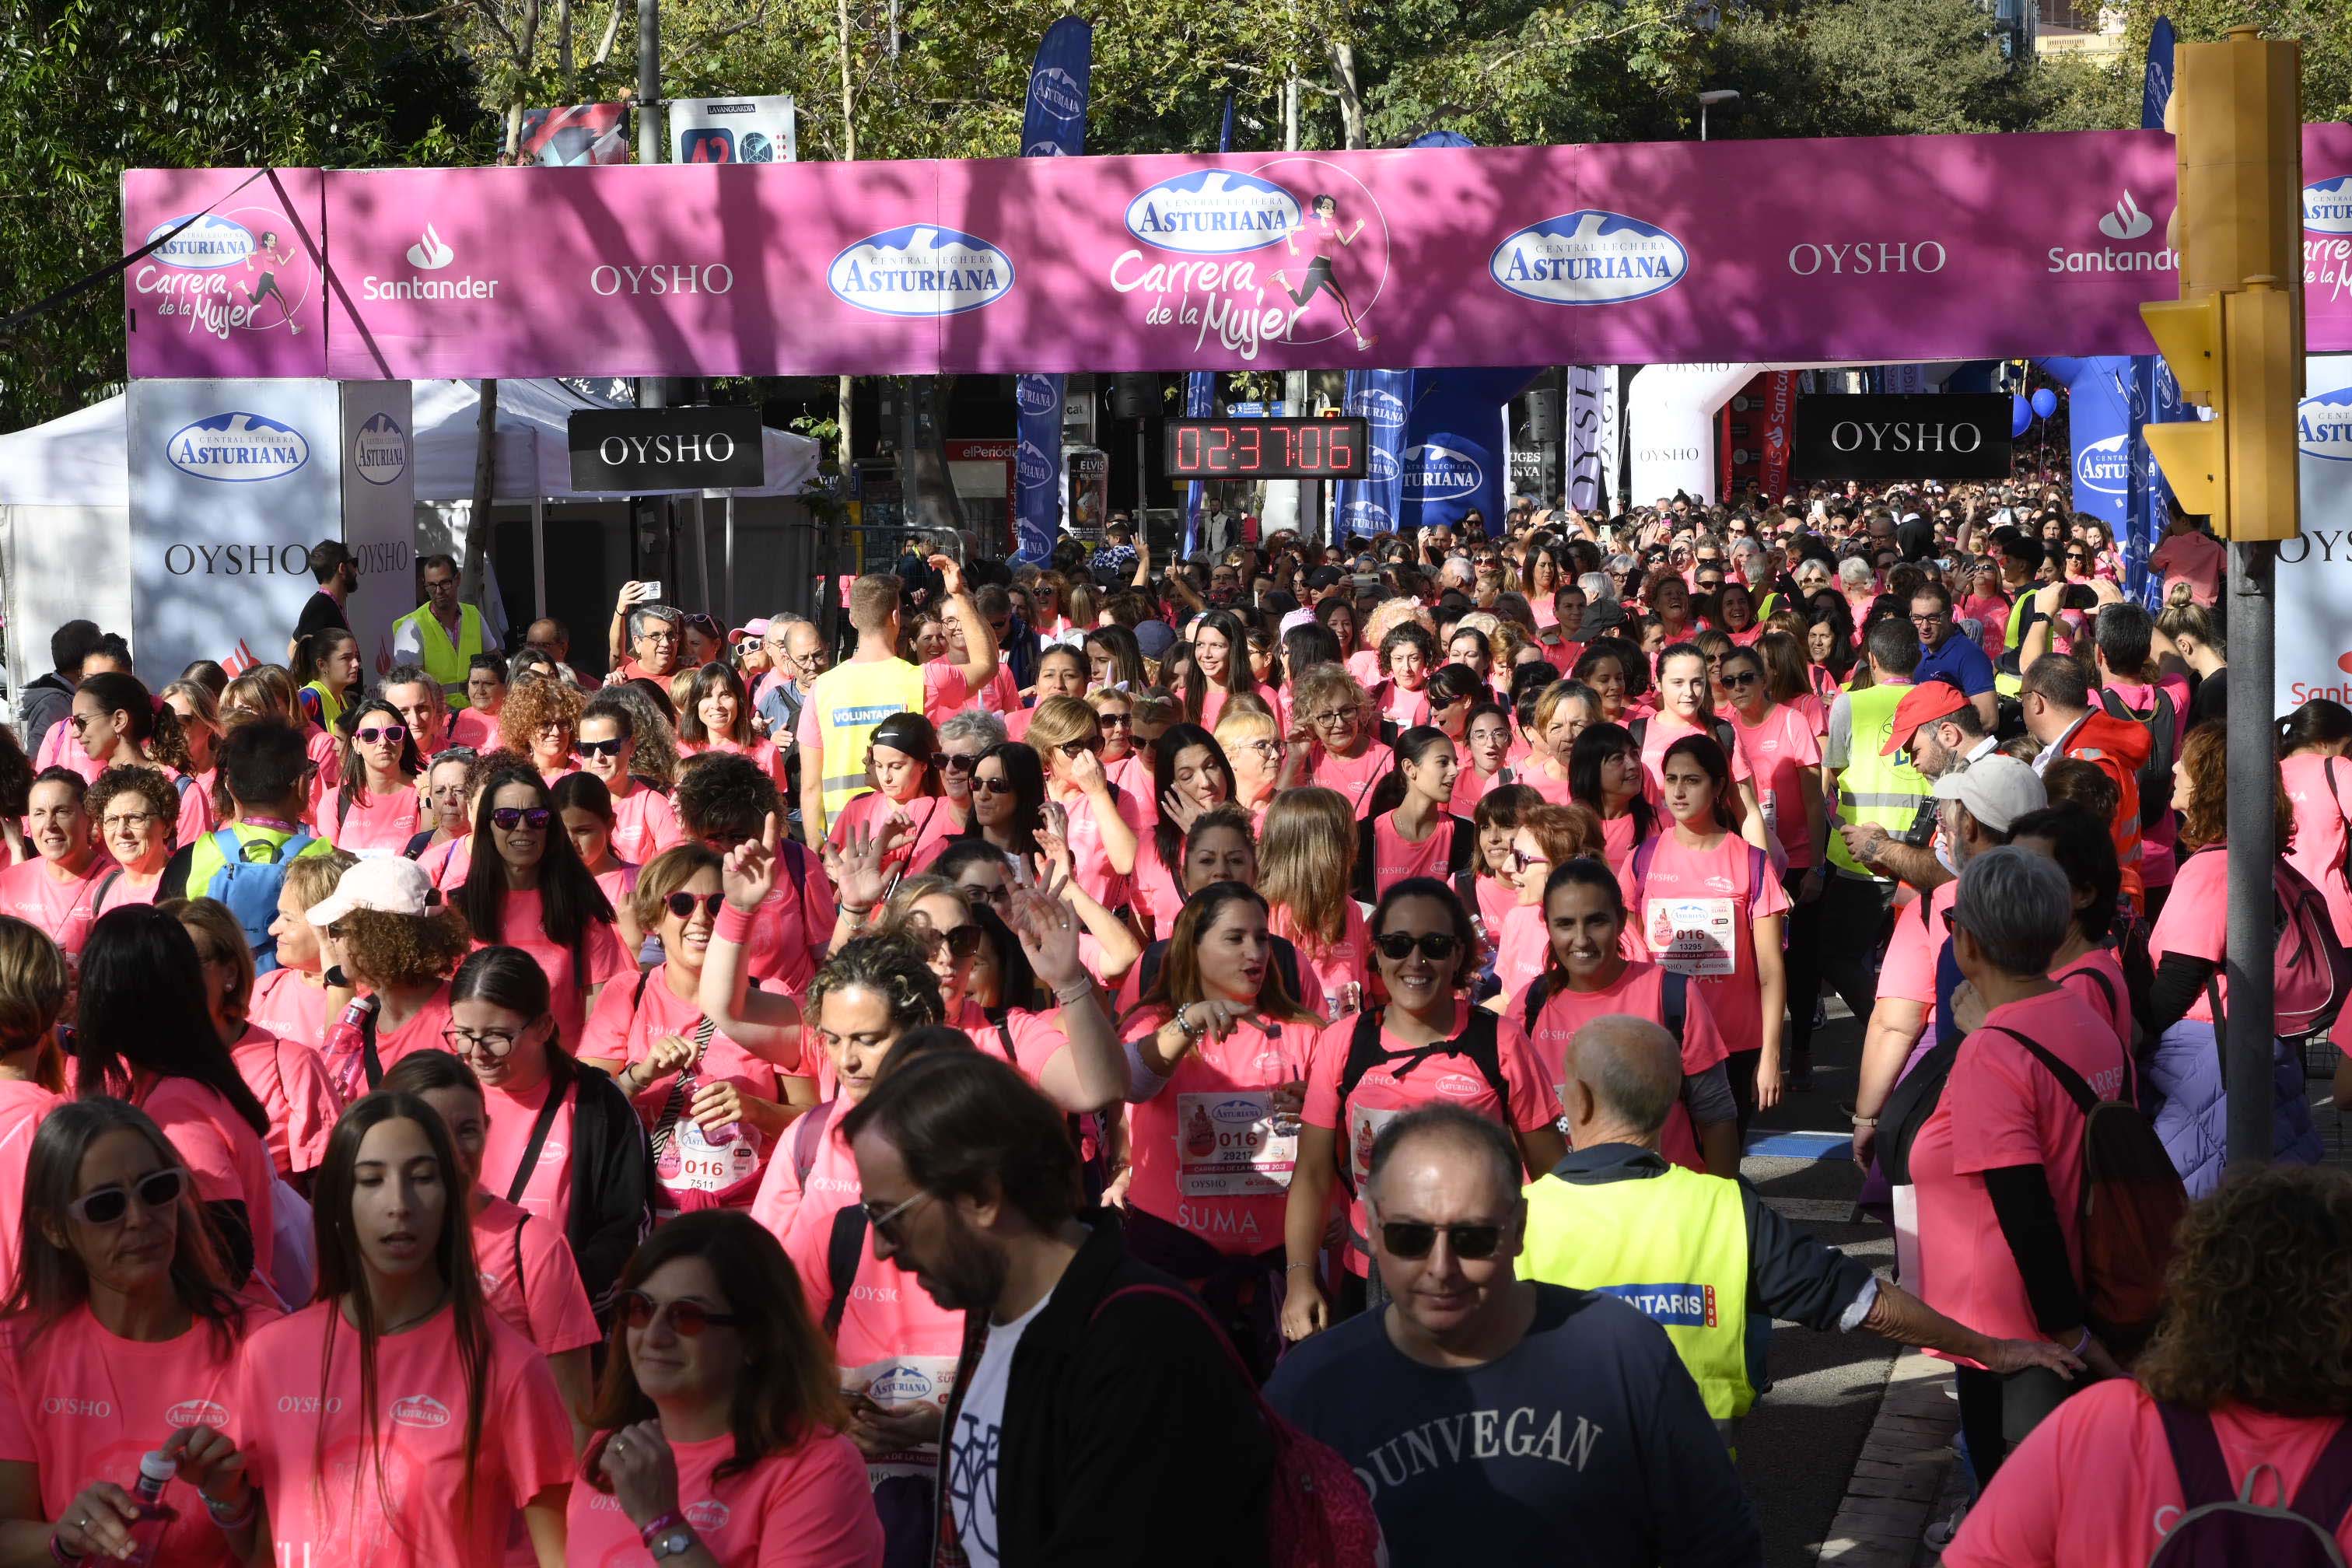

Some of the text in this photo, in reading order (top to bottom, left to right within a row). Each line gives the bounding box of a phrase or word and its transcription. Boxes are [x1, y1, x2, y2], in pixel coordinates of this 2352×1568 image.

[1139, 202, 1287, 233] ASTURIANA
[1535, 241, 1665, 254] CENTRAL LECHERA
[1788, 240, 1945, 275] OYSHO
[2304, 240, 2352, 261] arre
[870, 255, 930, 265] CENTRAL
[1504, 247, 1672, 281] ASTURIANA
[136, 265, 227, 294] Carrera
[590, 263, 733, 296] OYSHO
[842, 259, 1000, 292] ASTURIANA
[1110, 250, 1258, 293] Carrera
[2321, 262, 2333, 283] la
[363, 276, 499, 299] Santander
[158, 292, 261, 340] de la Mujer
[1146, 287, 1311, 361] de la Mujer
[199, 436, 244, 444] CENTRAL
[1831, 421, 1981, 453] OYSHO
[177, 439, 299, 464] ASTURIANA
[358, 439, 404, 467] ASTURIANA
[600, 432, 734, 466] OYSHO
[1178, 428, 1350, 470] 02:37:06
[1510, 452, 1541, 463] UGES
[1640, 447, 1699, 461] OYSHO
[1080, 460, 1104, 471] ELVIS
[1510, 467, 1539, 477] NYA
[1403, 473, 1475, 488] TURIANA
[165, 543, 311, 576] OYSHO
[357, 541, 408, 576] OYSHO
[1377, 866, 1409, 875] OYSHO
[1647, 872, 1679, 883] OYSHO
[1676, 929, 1705, 940] 016
[1216, 1109, 1262, 1118] ASTURIANA
[1219, 1132, 1257, 1146] 016
[1223, 1151, 1254, 1160] 29217
[684, 1160, 723, 1176] 016
[688, 1178, 712, 1188] 7511
[1192, 1179, 1227, 1189] OYSHO
[1178, 1204, 1258, 1233] SUMA
[1619, 1294, 1702, 1314] NTARIS
[873, 1381, 928, 1396] ASTURIANA
[44, 1397, 111, 1418] OYSHO
